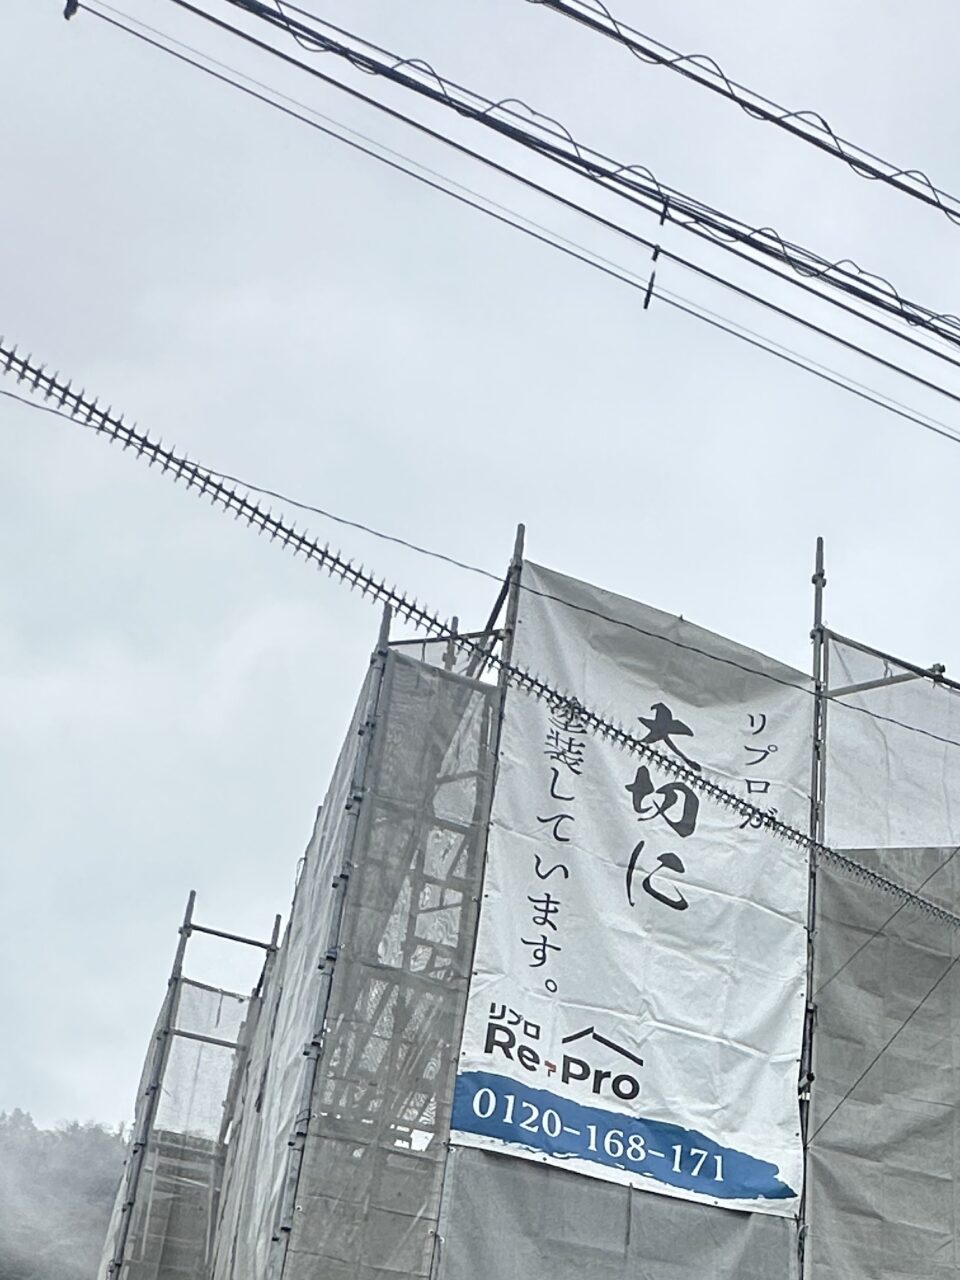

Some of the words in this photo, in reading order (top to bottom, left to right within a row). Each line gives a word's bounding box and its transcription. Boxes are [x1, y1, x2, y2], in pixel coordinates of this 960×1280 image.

[624, 701, 703, 911] 大切に
[471, 1087, 725, 1182] 0120-168-171
